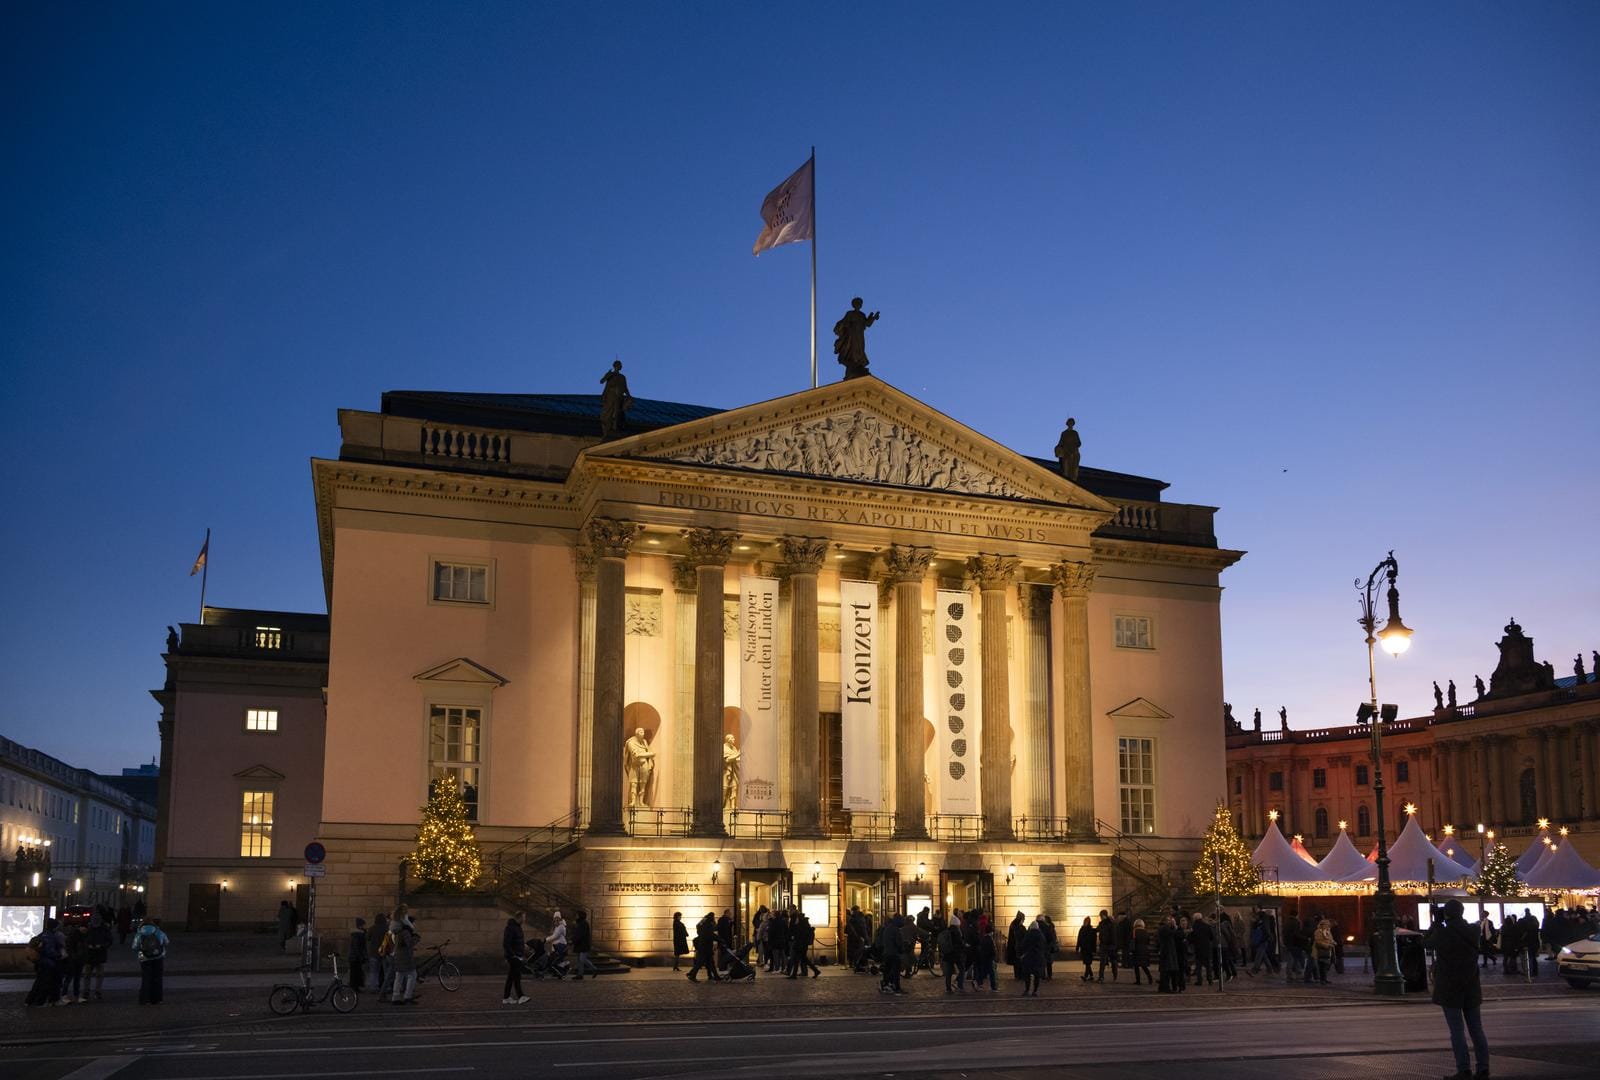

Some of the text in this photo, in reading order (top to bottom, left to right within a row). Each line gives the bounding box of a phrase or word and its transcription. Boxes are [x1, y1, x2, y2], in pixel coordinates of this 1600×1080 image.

[657, 490, 1047, 542] FRIDERICVS REX APOLLINI ET MVSIS
[744, 591, 760, 663] Staatsoper
[757, 592, 773, 711] Unter den Linden
[847, 601, 872, 705] Konzert
